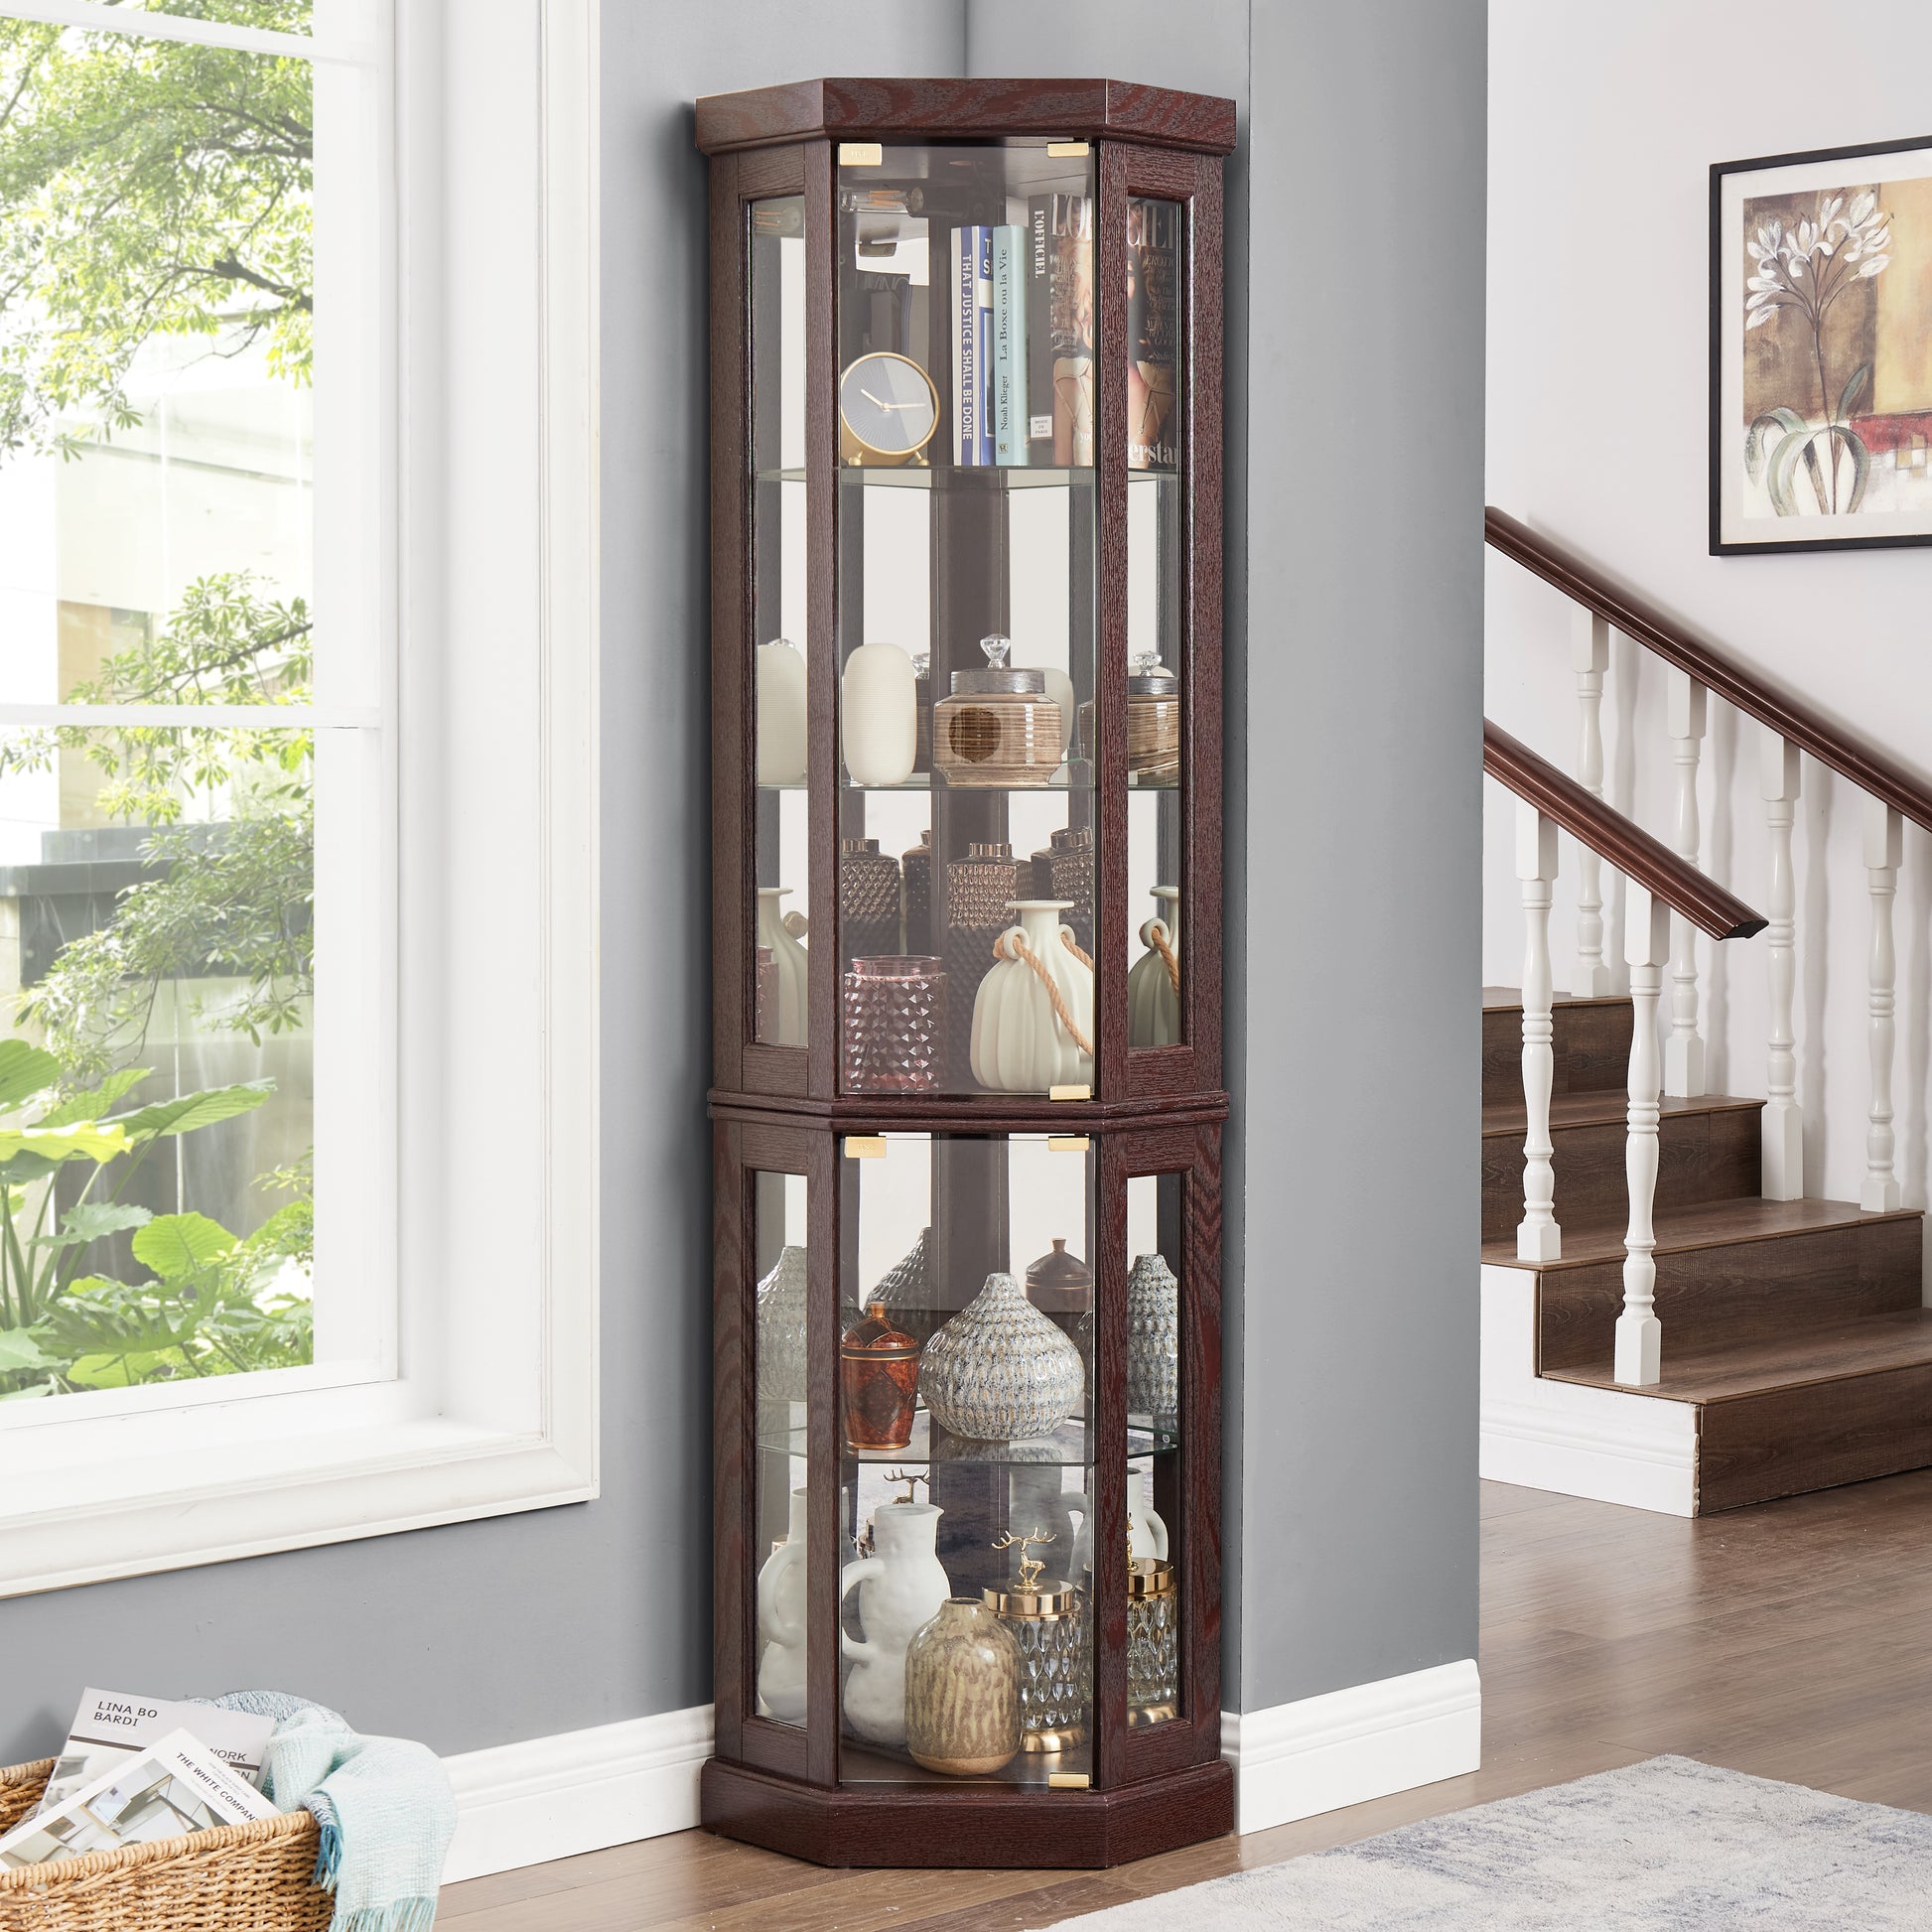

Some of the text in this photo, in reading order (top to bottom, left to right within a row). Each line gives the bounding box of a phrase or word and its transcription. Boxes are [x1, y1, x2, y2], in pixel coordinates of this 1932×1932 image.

[1000, 274, 1008, 285] la
[1002, 289, 1008, 305] ou
[962, 254, 972, 440] THAT JUSTICE SHALL BE DONE
[1000, 345, 1008, 361] La
[97, 1700, 158, 1719] LINA BO
[93, 1712, 139, 1726] BARDI
[176, 1751, 194, 1769] THE
[193, 1766, 220, 1792] WHITE
[219, 1790, 259, 1822] COMPAN
